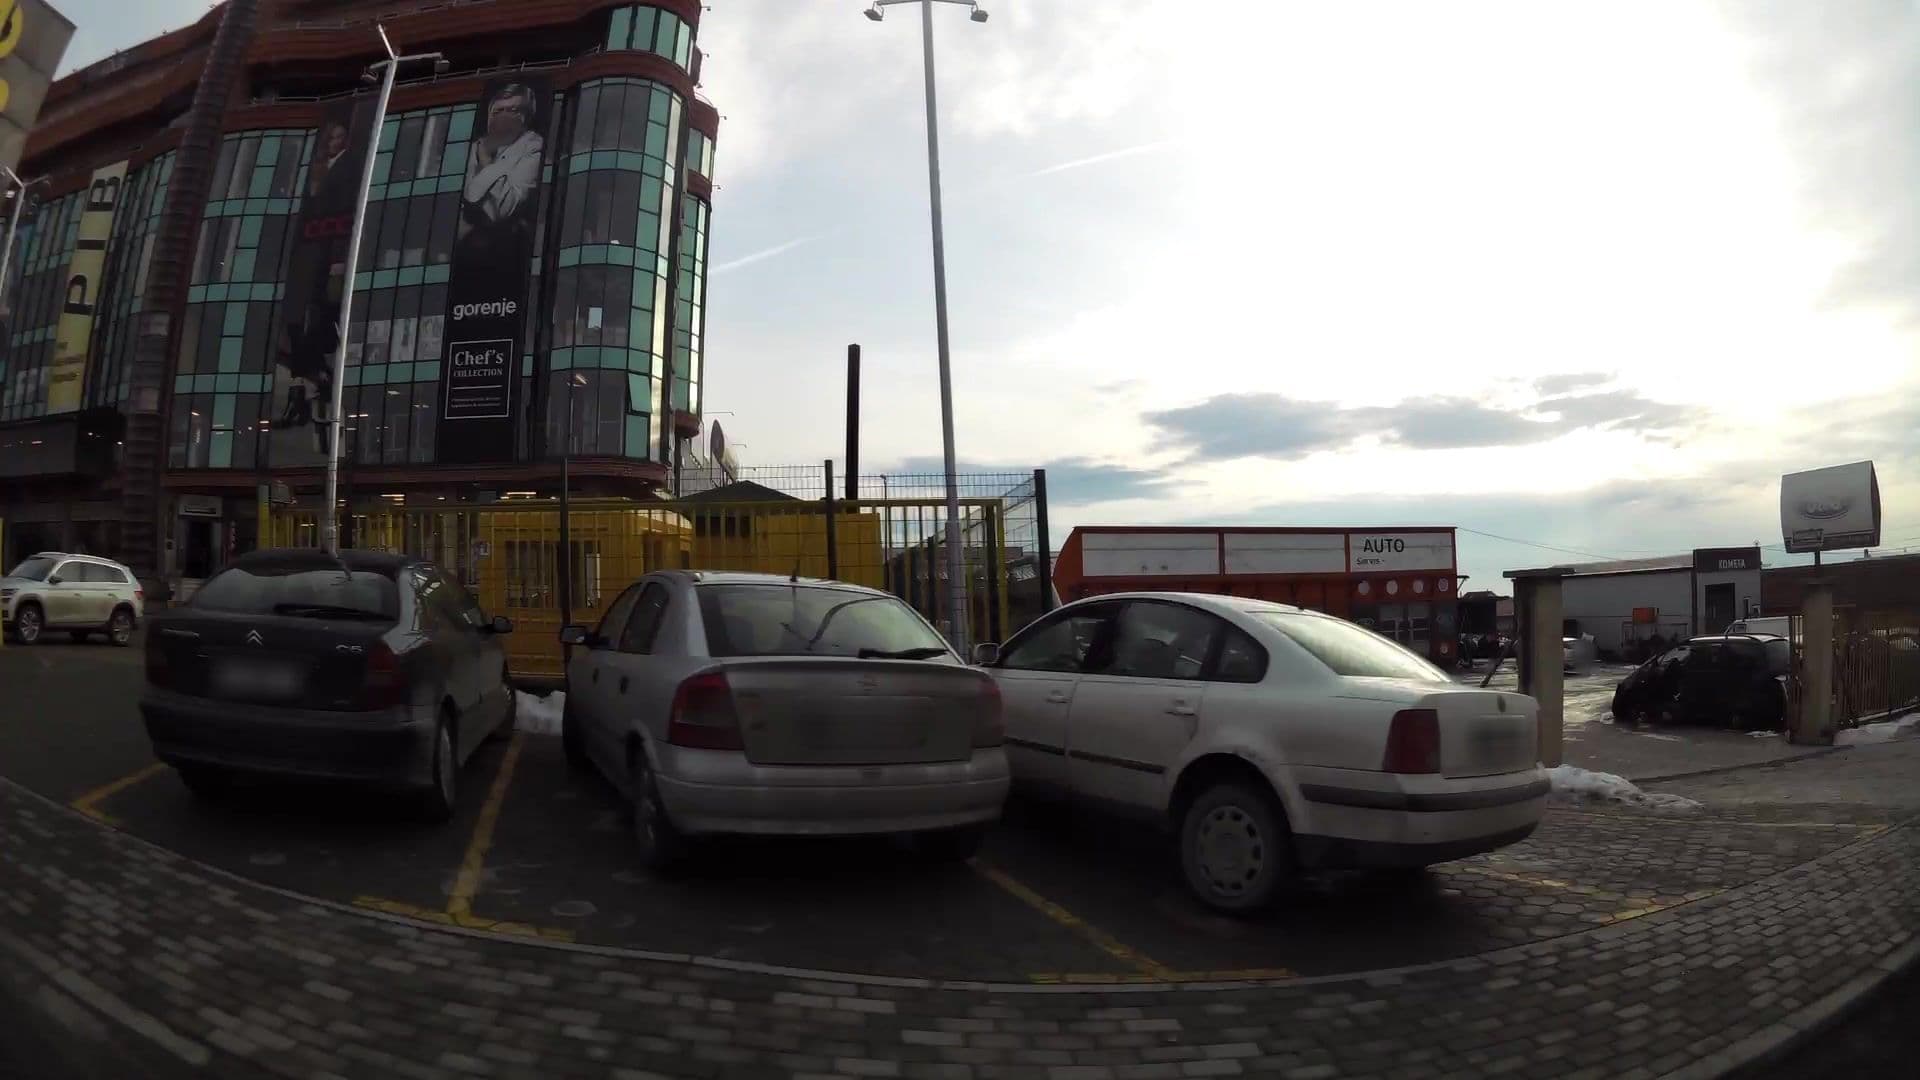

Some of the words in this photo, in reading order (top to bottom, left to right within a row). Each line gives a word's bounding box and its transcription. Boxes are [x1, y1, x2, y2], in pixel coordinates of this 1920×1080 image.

[453, 297, 517, 321] gorenje
[455, 349, 505, 366] Chef's
[453, 368, 504, 378] COLLECTION
[1363, 537, 1405, 554] AUTO
[1718, 558, 1746, 569] KOMETA
